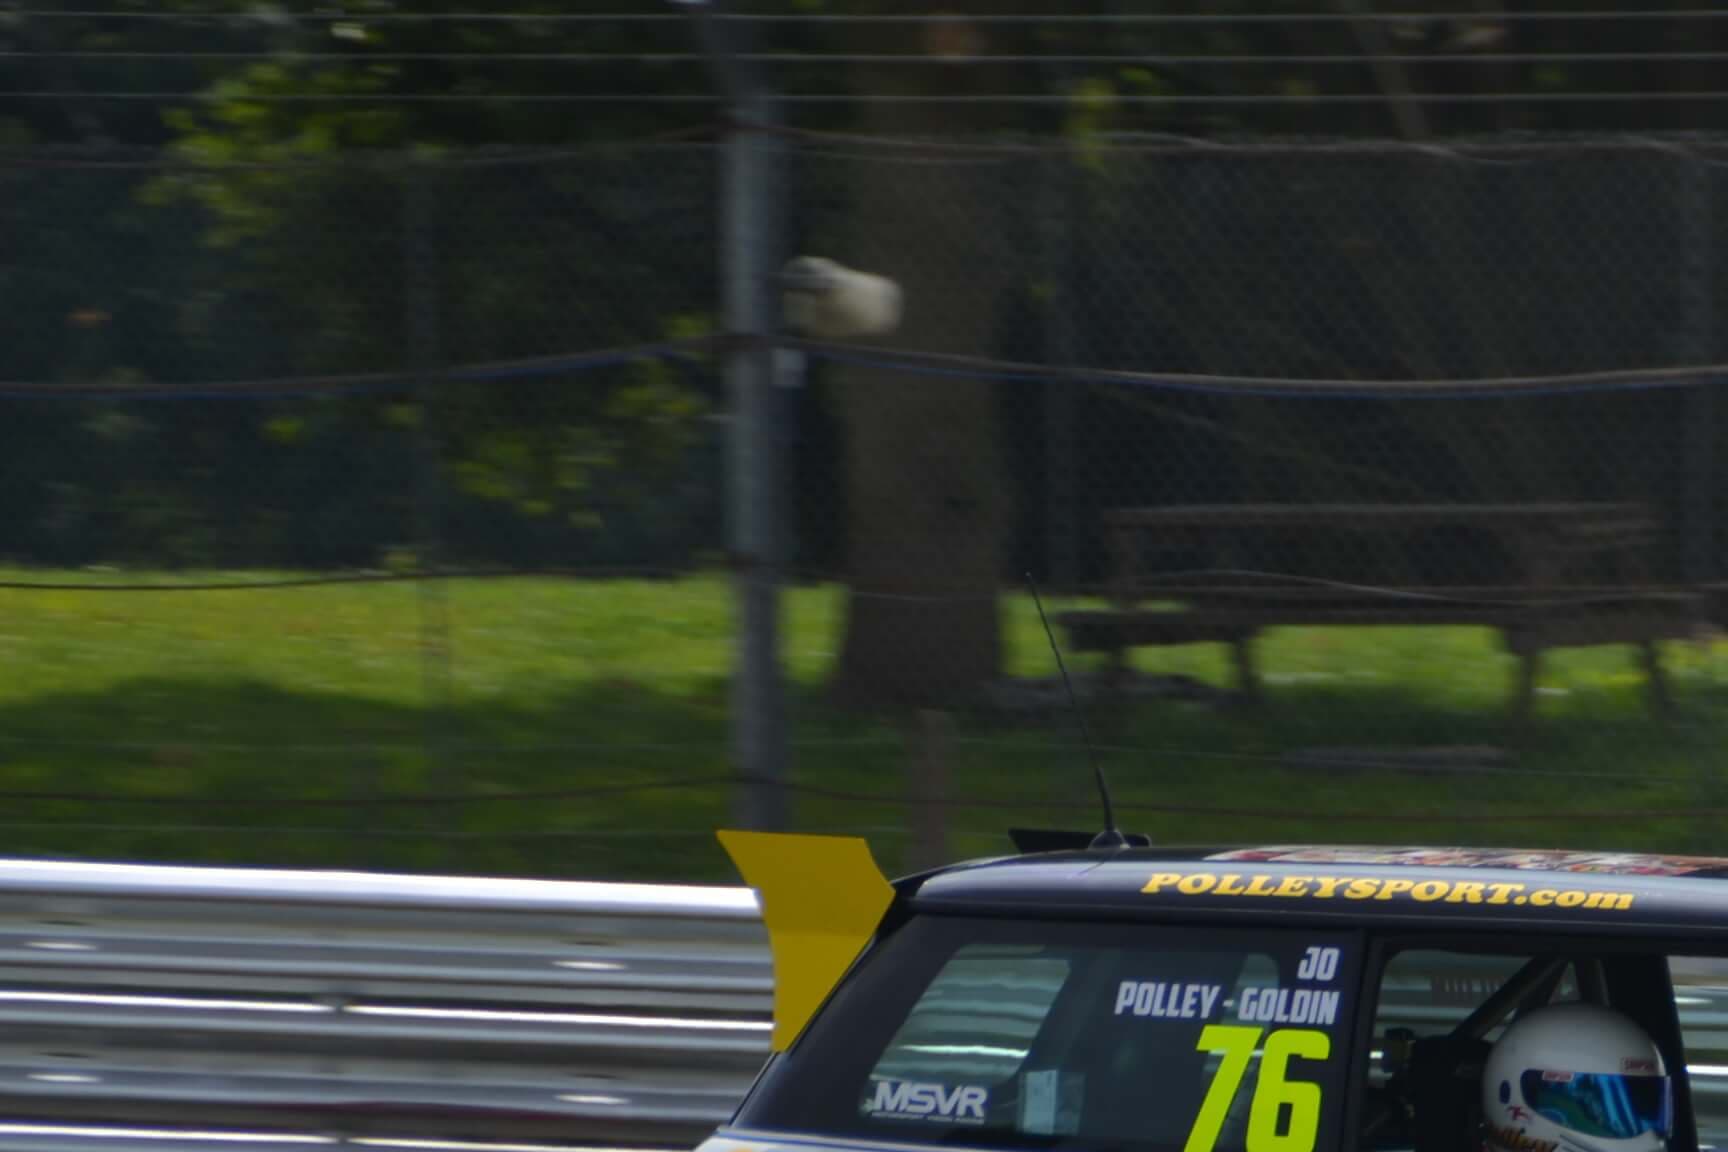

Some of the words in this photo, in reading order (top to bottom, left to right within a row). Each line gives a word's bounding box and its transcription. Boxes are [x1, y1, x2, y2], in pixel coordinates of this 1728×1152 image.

[1141, 872, 1634, 910] POLLEYSPORT.com
[1297, 947, 1340, 981] JO
[872, 1081, 987, 1117] MSVR
